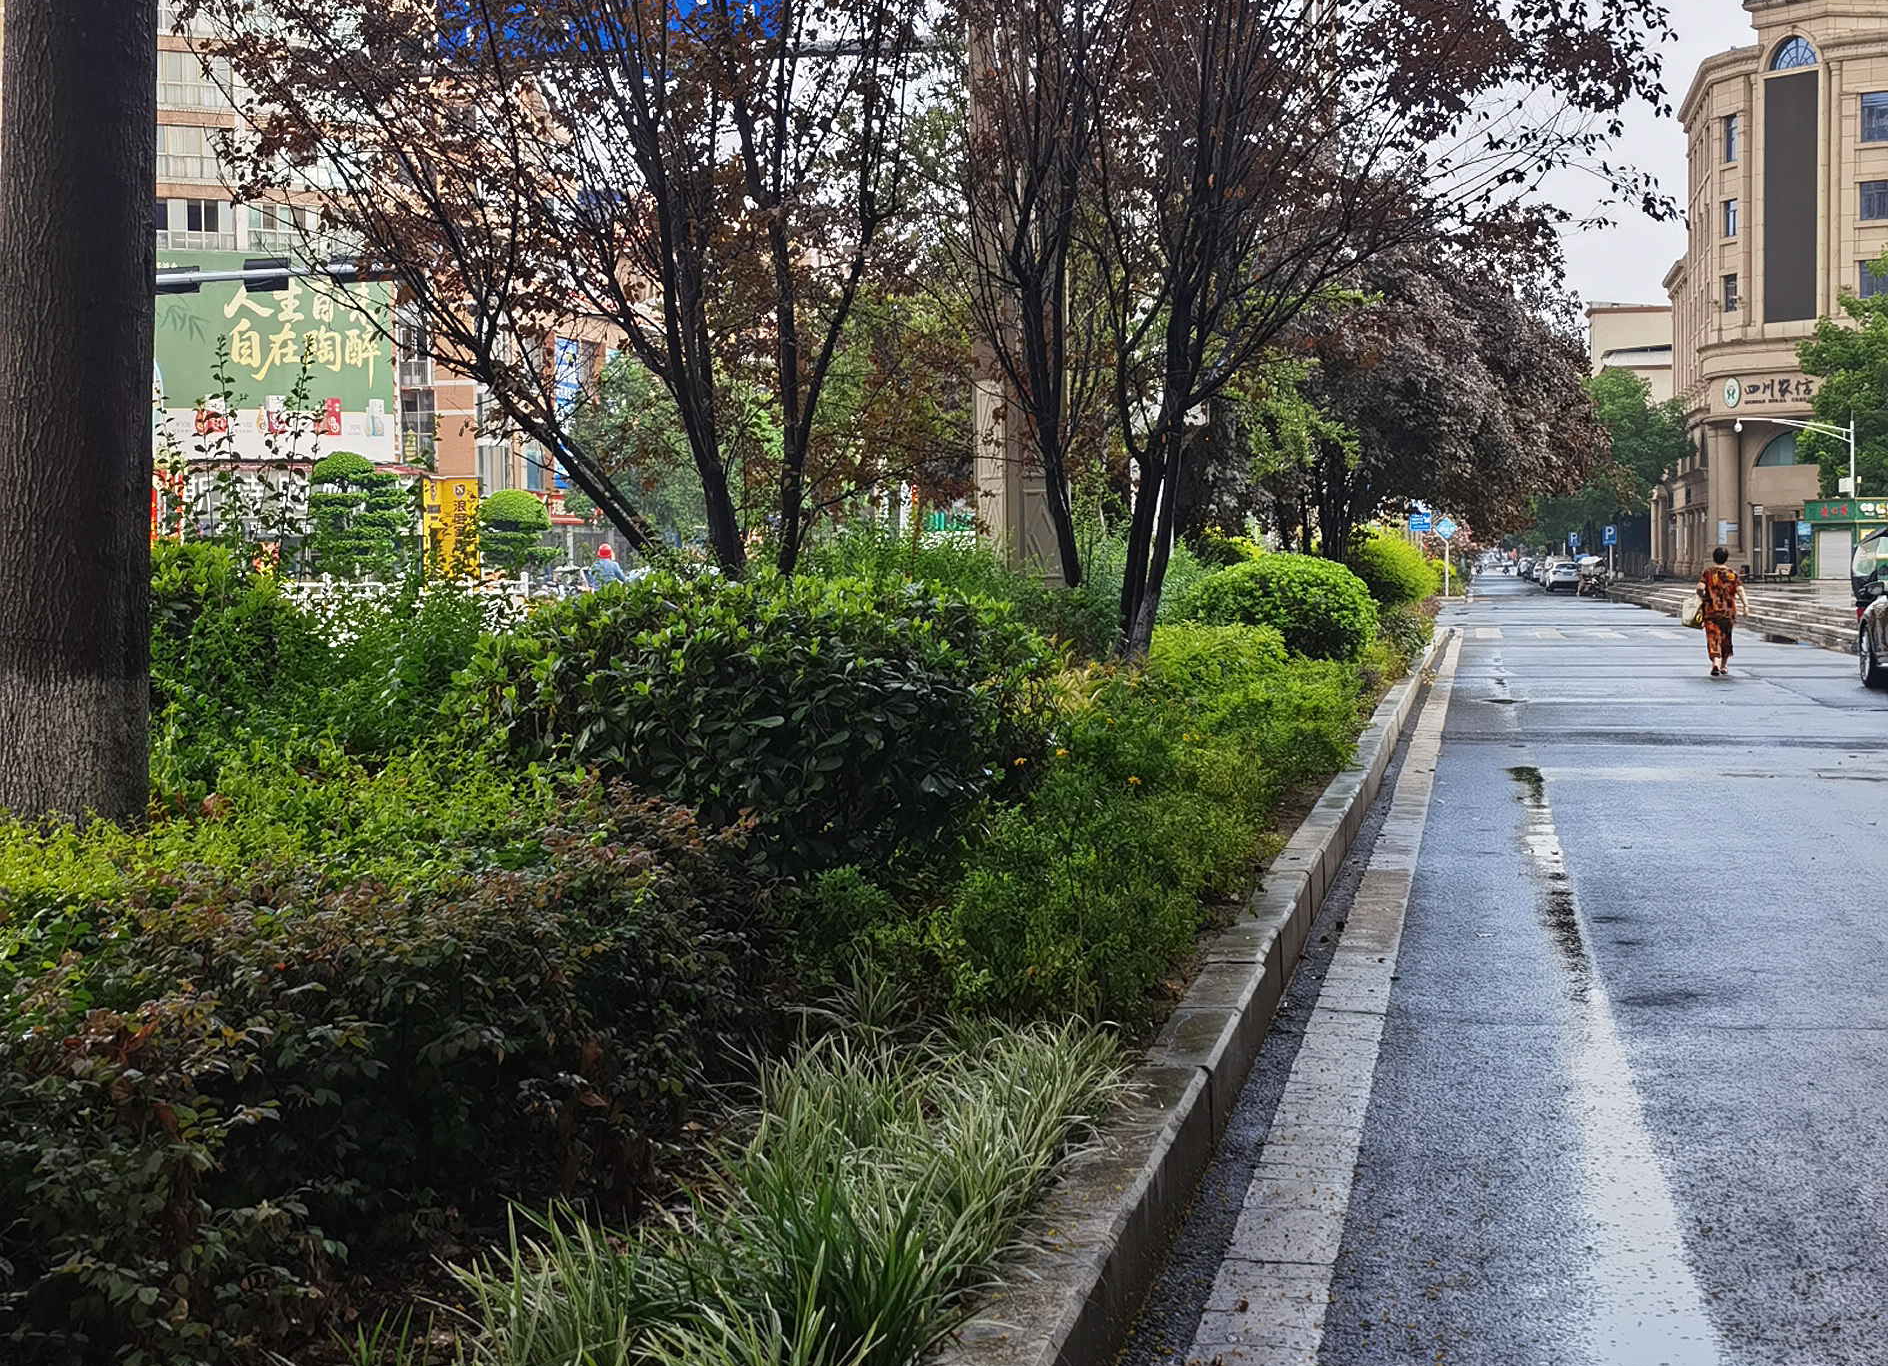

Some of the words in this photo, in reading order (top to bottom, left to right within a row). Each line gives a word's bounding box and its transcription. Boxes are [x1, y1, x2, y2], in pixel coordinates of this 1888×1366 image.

[223, 276, 379, 326] 人生百味
[229, 318, 381, 389] 自在陶醉
[1744, 378, 1814, 398] 四川农信
[1570, 532, 1578, 543] P
[1605, 526, 1614, 540] P
